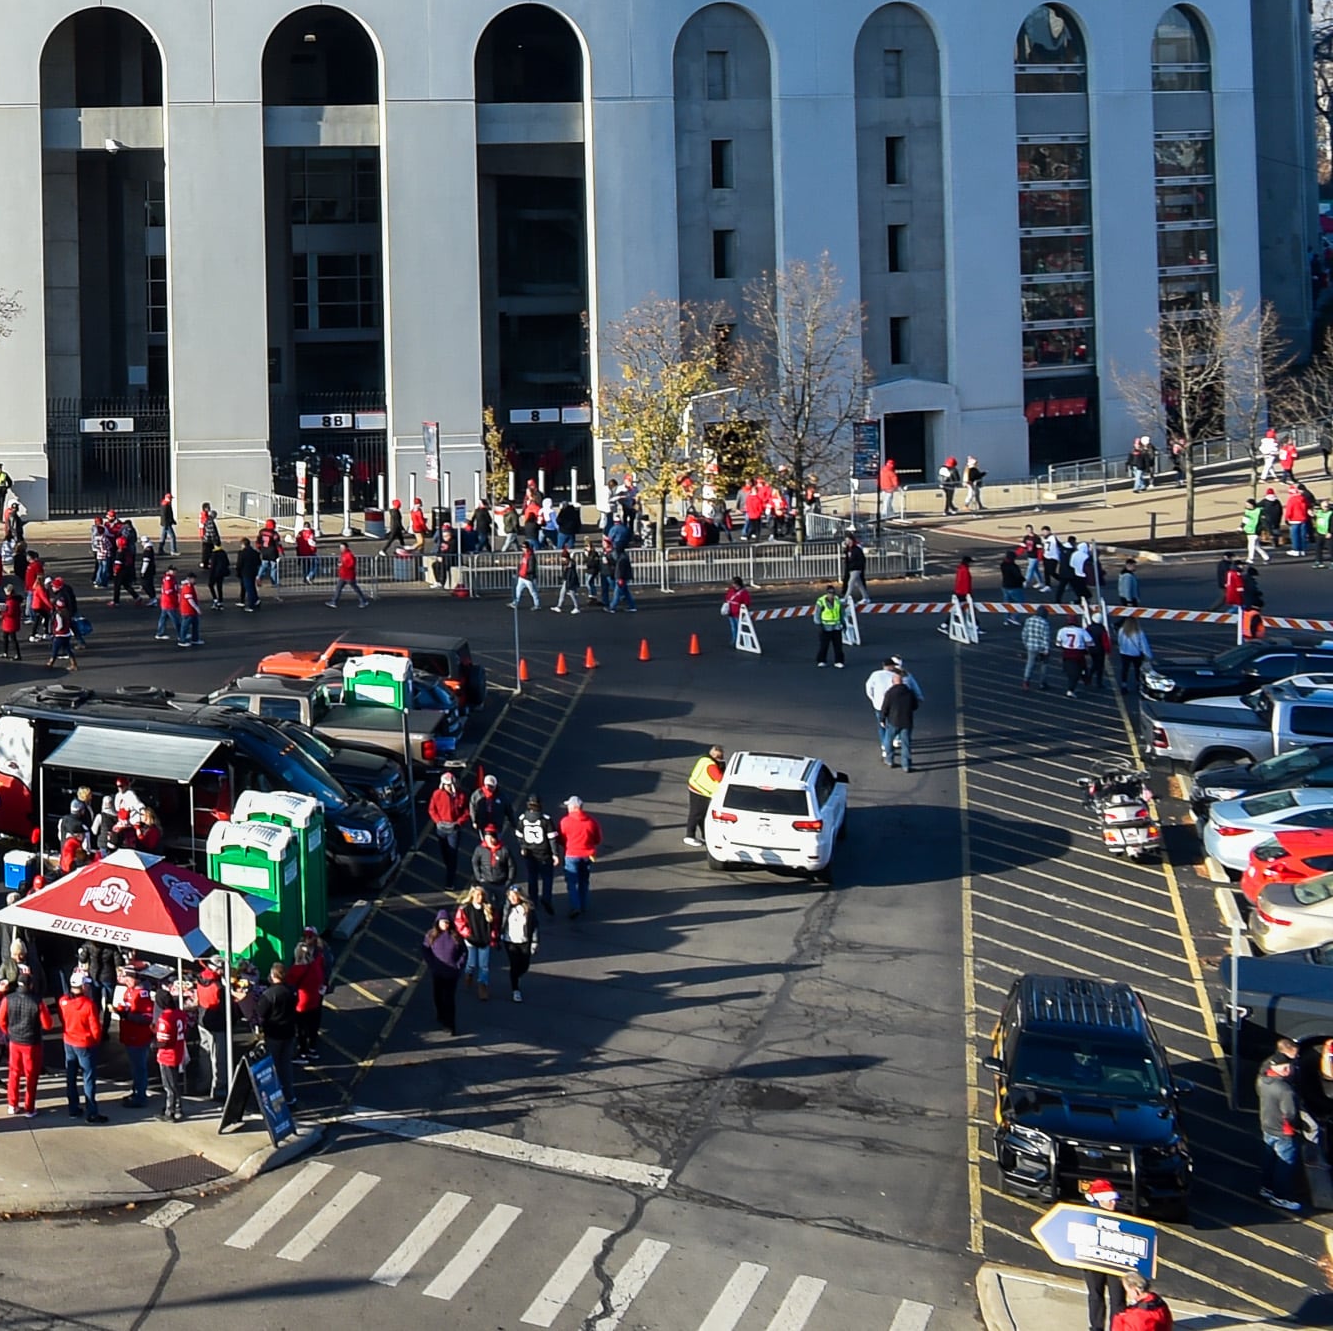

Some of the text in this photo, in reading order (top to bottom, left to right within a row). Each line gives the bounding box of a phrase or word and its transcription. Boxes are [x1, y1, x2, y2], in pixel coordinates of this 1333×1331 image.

[531, 410, 540, 421] 8
[99, 420, 116, 431] 10
[322, 416, 343, 427] 8B
[1066, 633, 1076, 648] 7
[50, 919, 132, 942] BUCKEYES
